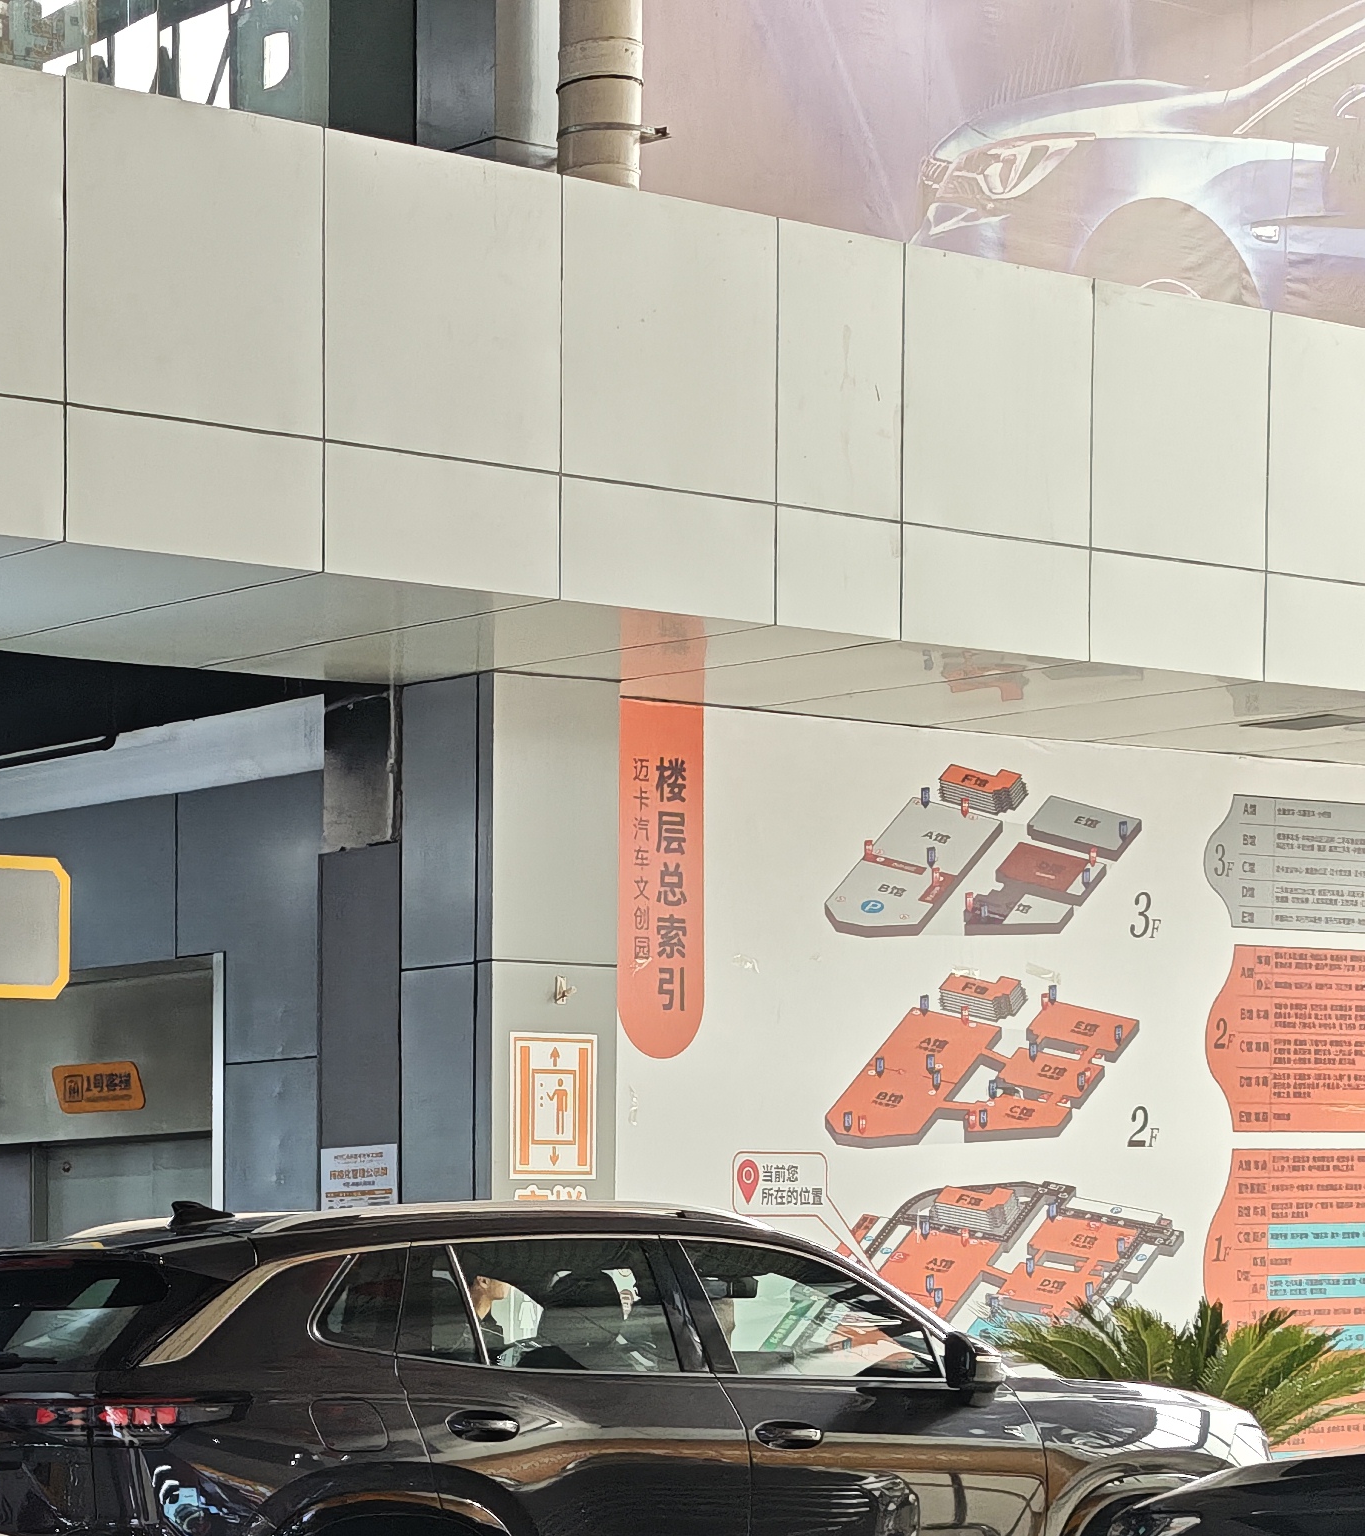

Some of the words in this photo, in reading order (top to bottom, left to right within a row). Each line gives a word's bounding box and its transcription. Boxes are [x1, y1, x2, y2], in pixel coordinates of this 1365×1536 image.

[632, 757, 652, 962] 迈卡汽车文创园
[655, 756, 687, 1012] 楼层总索引
[1129, 891, 1162, 940] 3F
[1127, 1105, 1160, 1148] 2F
[760, 1164, 800, 1184] 当前您
[760, 1186, 825, 1207] 所在的位置
